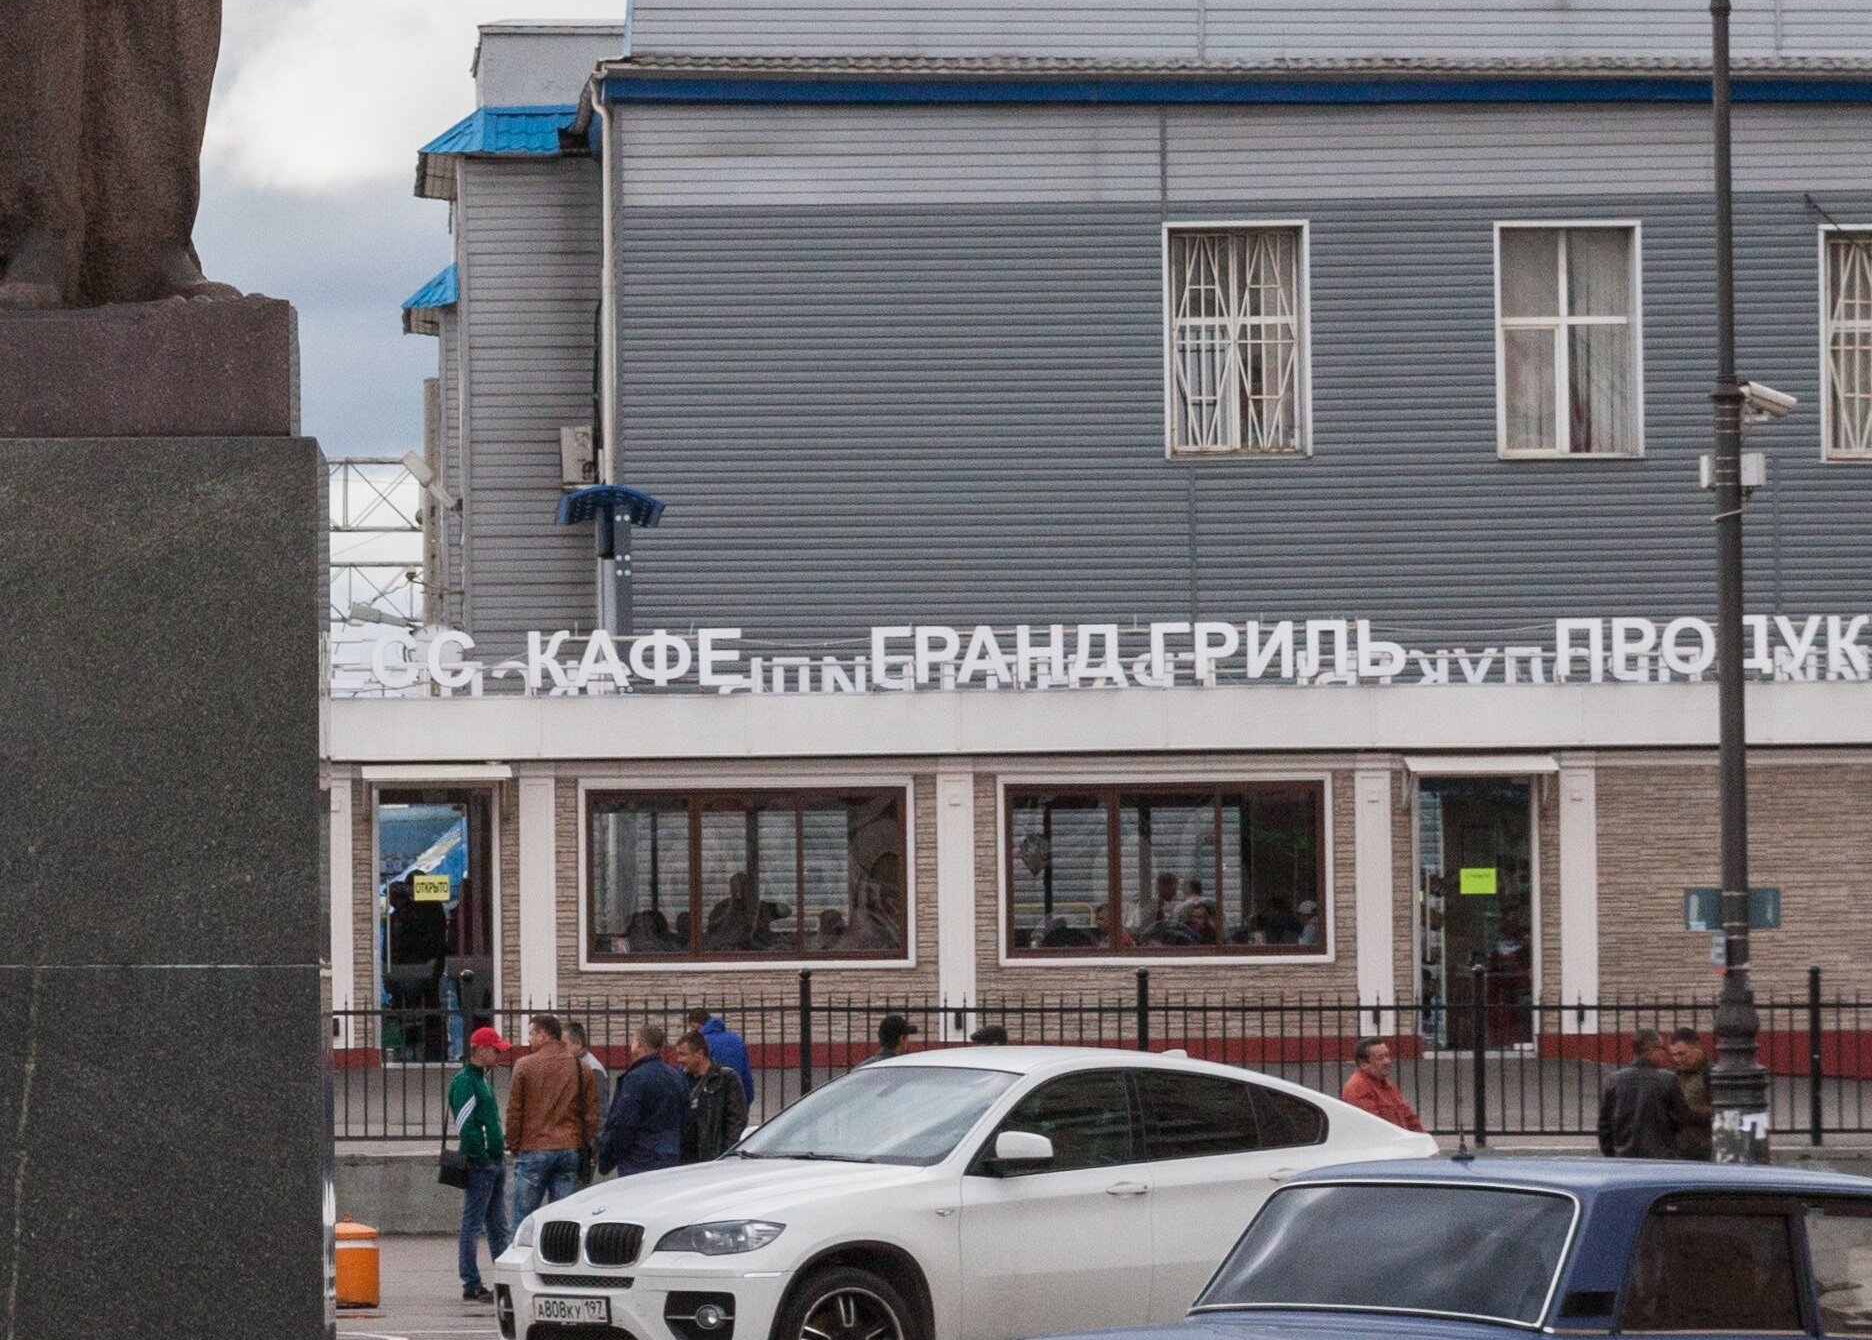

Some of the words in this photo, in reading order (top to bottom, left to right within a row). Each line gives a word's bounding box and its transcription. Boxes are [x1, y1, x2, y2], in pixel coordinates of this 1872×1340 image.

[528, 628, 745, 688] КАФЕ
[871, 623, 1128, 688] ГРАНД
[1150, 618, 1408, 680] ГРИЛЬ
[415, 881, 449, 894] ОТКРЫТО
[584, 1300, 602, 1315] 197
